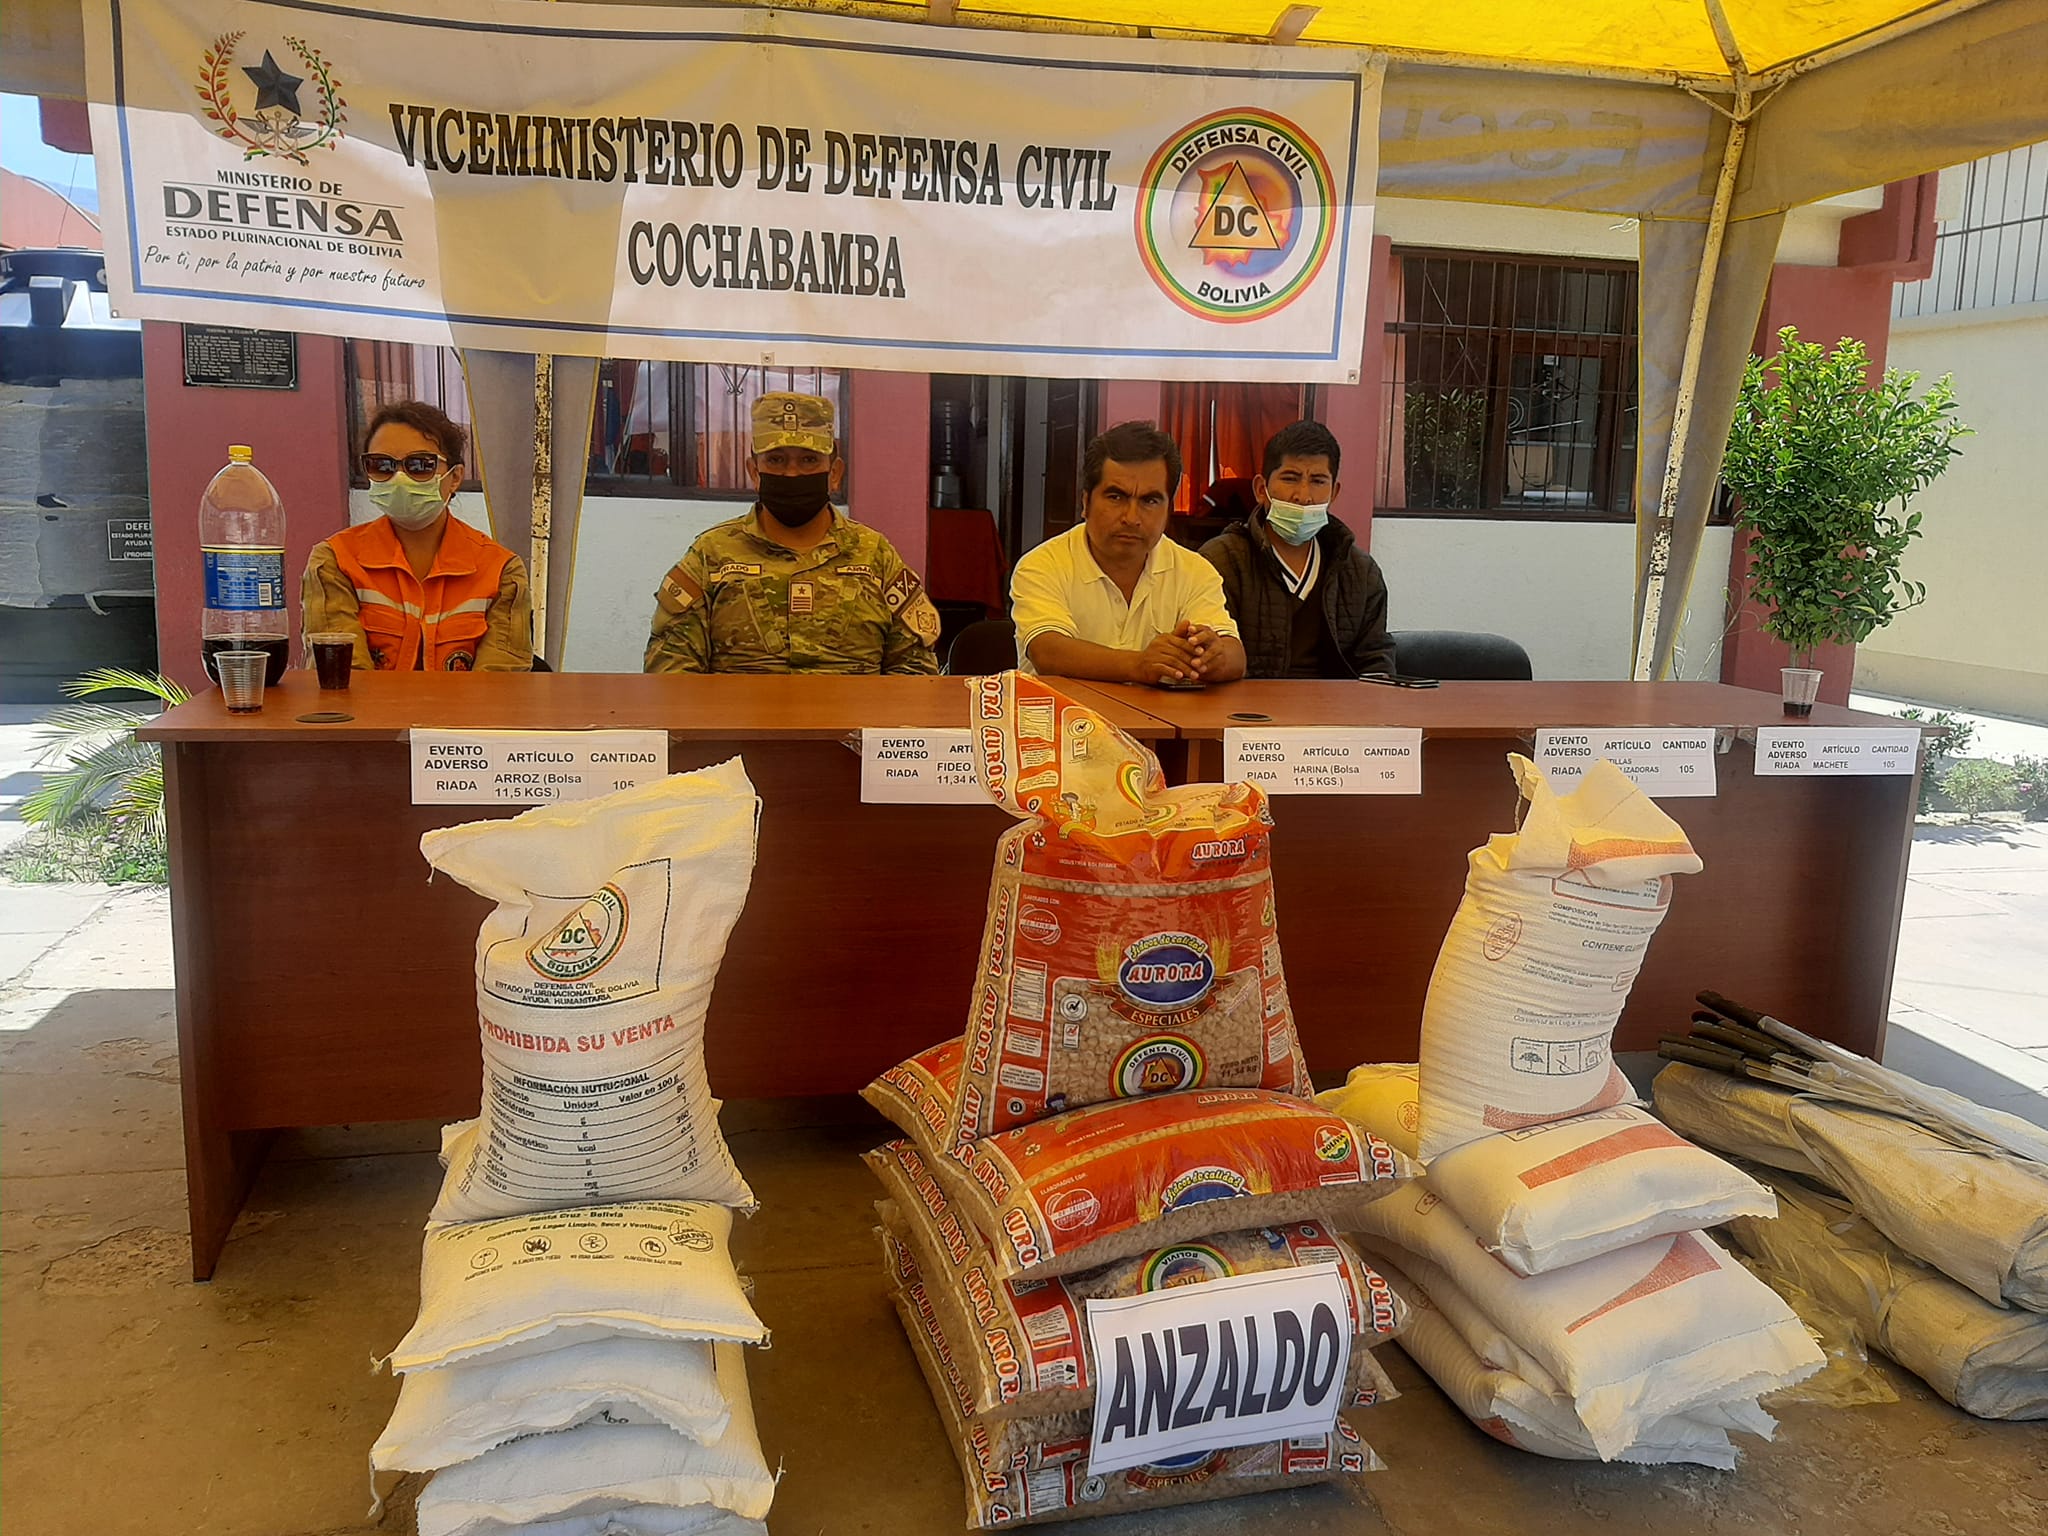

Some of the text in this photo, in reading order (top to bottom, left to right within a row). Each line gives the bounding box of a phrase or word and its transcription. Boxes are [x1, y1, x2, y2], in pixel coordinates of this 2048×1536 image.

[388, 103, 1118, 211] VICEMINISTERIO DE DEFENSA CIVIL
[1171, 127, 1309, 180] DEFENSA CIVIL
[217, 170, 343, 196] MINISTERIO DE
[163, 186, 404, 241] DEFENSA
[1213, 205, 1258, 237] DC
[166, 227, 403, 259] ESTADO PLURINACIONAL DE BOLIVIA
[627, 220, 906, 298] COCHABAMBA
[144, 245, 426, 291] Por por la patria y por nuestro futuro
[1197, 281, 1271, 304] BOLIVIA
[882, 739, 925, 748] EVENTO
[1548, 736, 1588, 745] EVENTO
[1604, 740, 1651, 750] ARTÍCULO
[1662, 741, 1707, 750] CANTIDAD
[1771, 741, 1805, 749] EVENTO
[429, 745, 483, 756] EVENTO
[1242, 742, 1281, 752] EVENTO
[1303, 746, 1349, 756] ARTÍCULO
[1364, 748, 1410, 757] CANTIDAD
[1543, 747, 1592, 757] ADVERSO
[1822, 744, 1860, 754] ARTÍCULO
[507, 751, 574, 763] ARTÍCULO
[590, 753, 657, 763] CANTIDAD
[877, 750, 929, 759] ADVERSO
[1238, 753, 1285, 762] ADVERSO
[1767, 751, 1807, 759] ADVERSO
[424, 759, 488, 770] ADVERSO
[937, 762, 972, 772] FIDEO
[1293, 765, 1360, 775] HARINA (Bolsa
[1679, 765, 1695, 774] 105
[1774, 761, 1800, 769] RIADA
[1813, 761, 1849, 769] MACHETE
[886, 769, 919, 778] RIADA
[1379, 771, 1396, 780] 105
[1551, 766, 1582, 776] RIADA
[494, 773, 582, 785] ARROZ (Bolsa
[613, 780, 635, 790] 105
[937, 776, 966, 786] 11,34
[1294, 777, 1344, 788] 11,5 KGS.)
[436, 780, 478, 791] RIADA
[495, 787, 561, 799] 11,5 KGS.)
[1191, 839, 1246, 860] AURORA
[1552, 902, 1599, 918] COMPOSICIÓN
[560, 928, 586, 944] DC
[988, 886, 1010, 977] AURORA
[1581, 939, 1624, 952] CONTIENE
[547, 956, 599, 973] BOLIVIA
[1126, 961, 1204, 983] AURORA
[524, 988, 593, 998] PLURINACIONAL
[608, 980, 640, 992] BOLIVIA
[534, 981, 596, 990] DEFENSA CIVIL
[522, 993, 612, 1005] AYUDA HUMANITARIA
[1131, 1007, 1201, 1027] ESPECIALES
[577, 1034, 605, 1052] SU
[611, 1014, 675, 1047] VENTA
[970, 984, 999, 1075] AURORA
[1130, 1046, 1190, 1069] DEFENSA CIVIL
[513, 1072, 650, 1094] INFORMACIÓN NUTRICIONAL
[1150, 1072, 1169, 1084] DC
[563, 1100, 599, 1110] Unidad
[618, 1090, 643, 1103] Valor
[657, 1077, 673, 1091] 100
[957, 1083, 983, 1145] AURO
[577, 1144, 597, 1153] kcal
[1320, 1133, 1348, 1155] BOLIVIA
[559, 1211, 581, 1219] Cruz
[590, 1210, 624, 1219] Bolivia
[1002, 1207, 1040, 1268] AURO
[985, 1328, 1021, 1403] AUROR
[1101, 1301, 1342, 1444] ANZALDO
